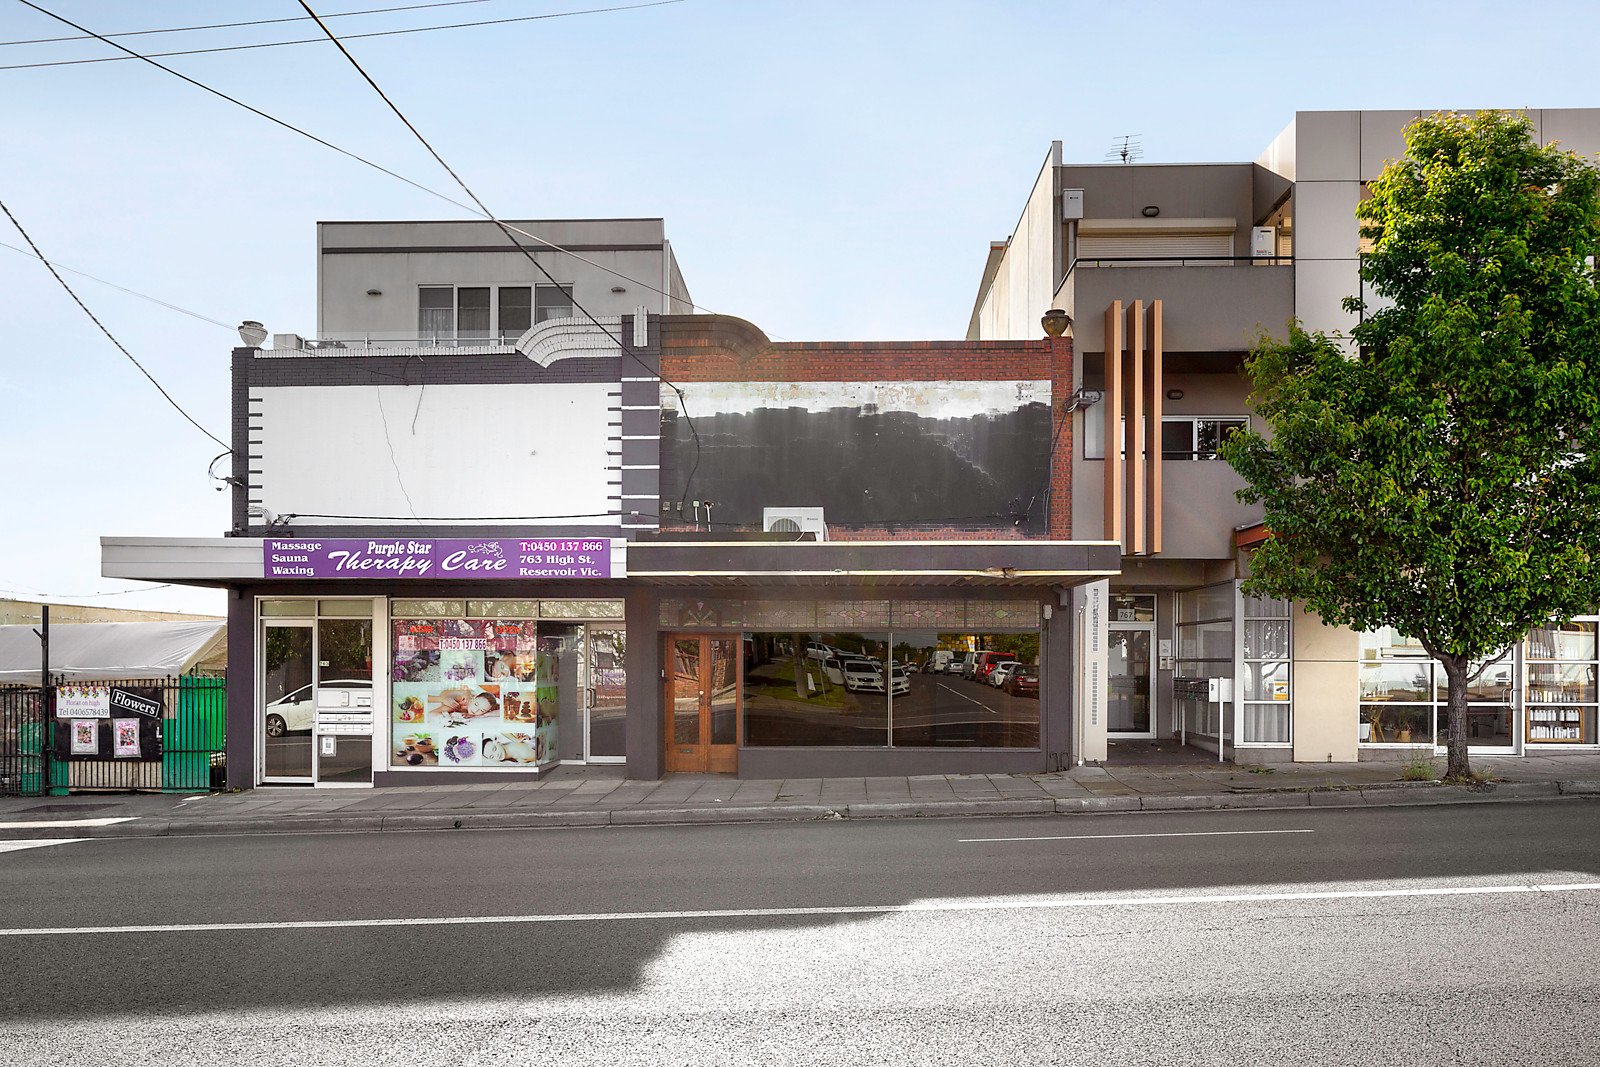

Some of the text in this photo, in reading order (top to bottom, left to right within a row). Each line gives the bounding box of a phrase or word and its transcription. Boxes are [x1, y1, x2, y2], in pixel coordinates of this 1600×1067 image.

[272, 542, 322, 551] Massage
[367, 541, 431, 556] Purple Star
[519, 541, 603, 551] T:0450 137 866
[272, 554, 309, 563] Sauna
[327, 550, 507, 576] Therapy Care
[519, 555, 542, 564] 763
[546, 555, 575, 565] High
[272, 566, 314, 576] Waxing
[519, 567, 602, 577] Reservoir Vic.
[1119, 611, 1133, 619] 767
[462, 639, 473, 649] 137
[474, 639, 487, 649] 866
[114, 692, 156, 715] Flowers
[59, 708, 69, 716] Tel
